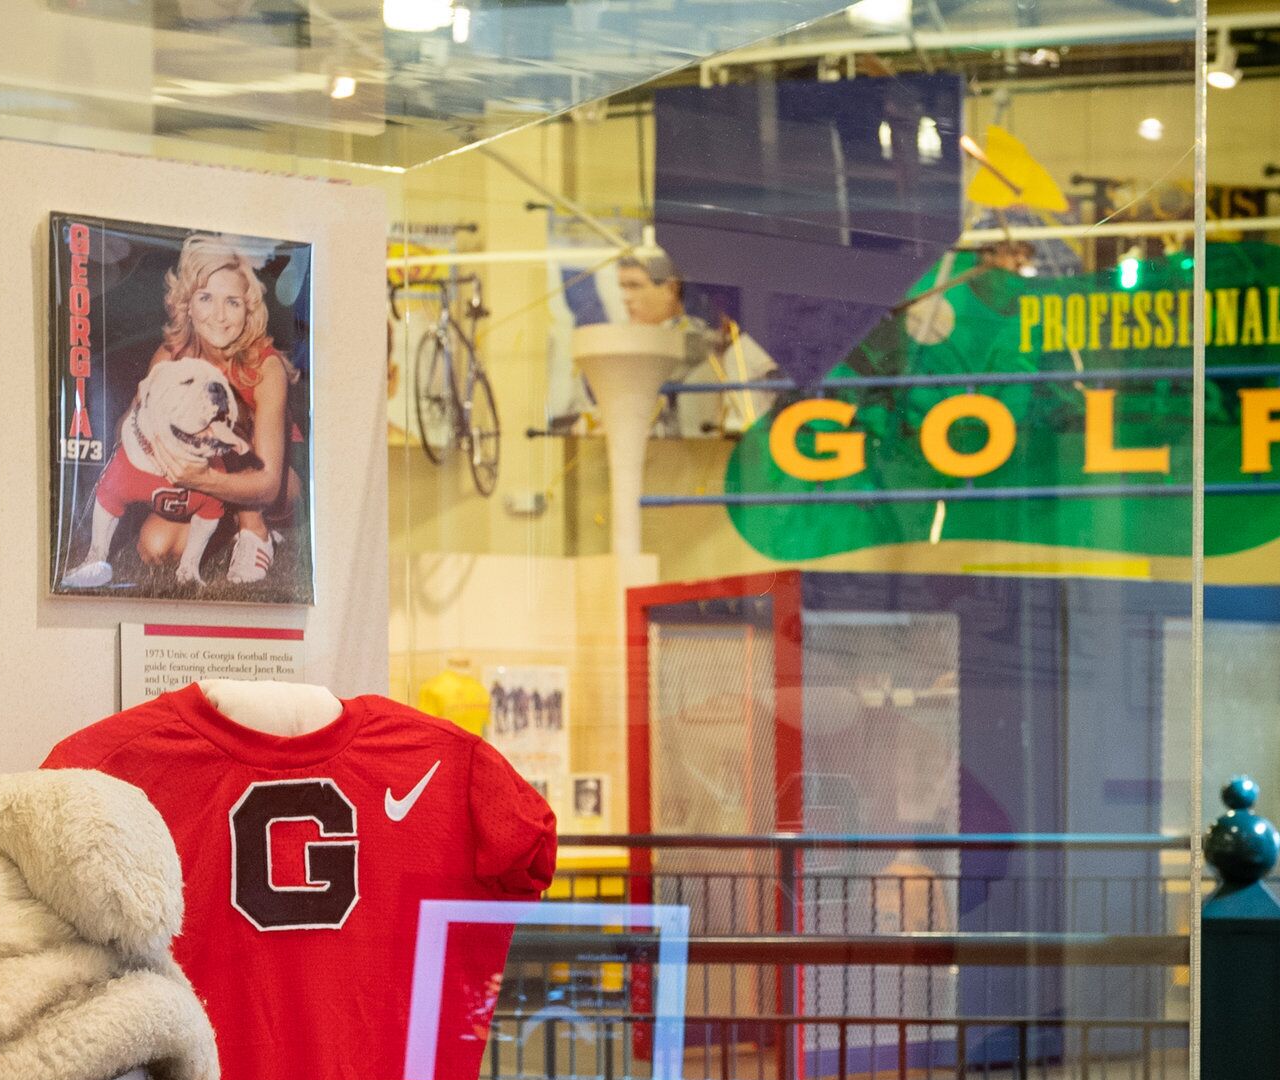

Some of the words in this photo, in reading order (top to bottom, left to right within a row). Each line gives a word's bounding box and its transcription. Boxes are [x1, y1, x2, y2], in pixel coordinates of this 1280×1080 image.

[69, 224, 91, 438] GEORGIA
[60, 440, 102, 461] 1973
[145, 650, 165, 658] 1973
[167, 650, 187, 659] Univ.
[190, 650, 199, 659] of
[203, 651, 235, 662] Georgia
[237, 651, 268, 661] football
[270, 653, 293, 662] media
[144, 663, 167, 673] guide
[169, 664, 205, 674] featuring
[207, 664, 252, 673] cheerleader
[254, 665, 274, 675] Janet
[276, 665, 295, 674] Ross
[145, 675, 160, 684] and
[162, 676, 179, 685] Uga
[229, 777, 360, 933] G
